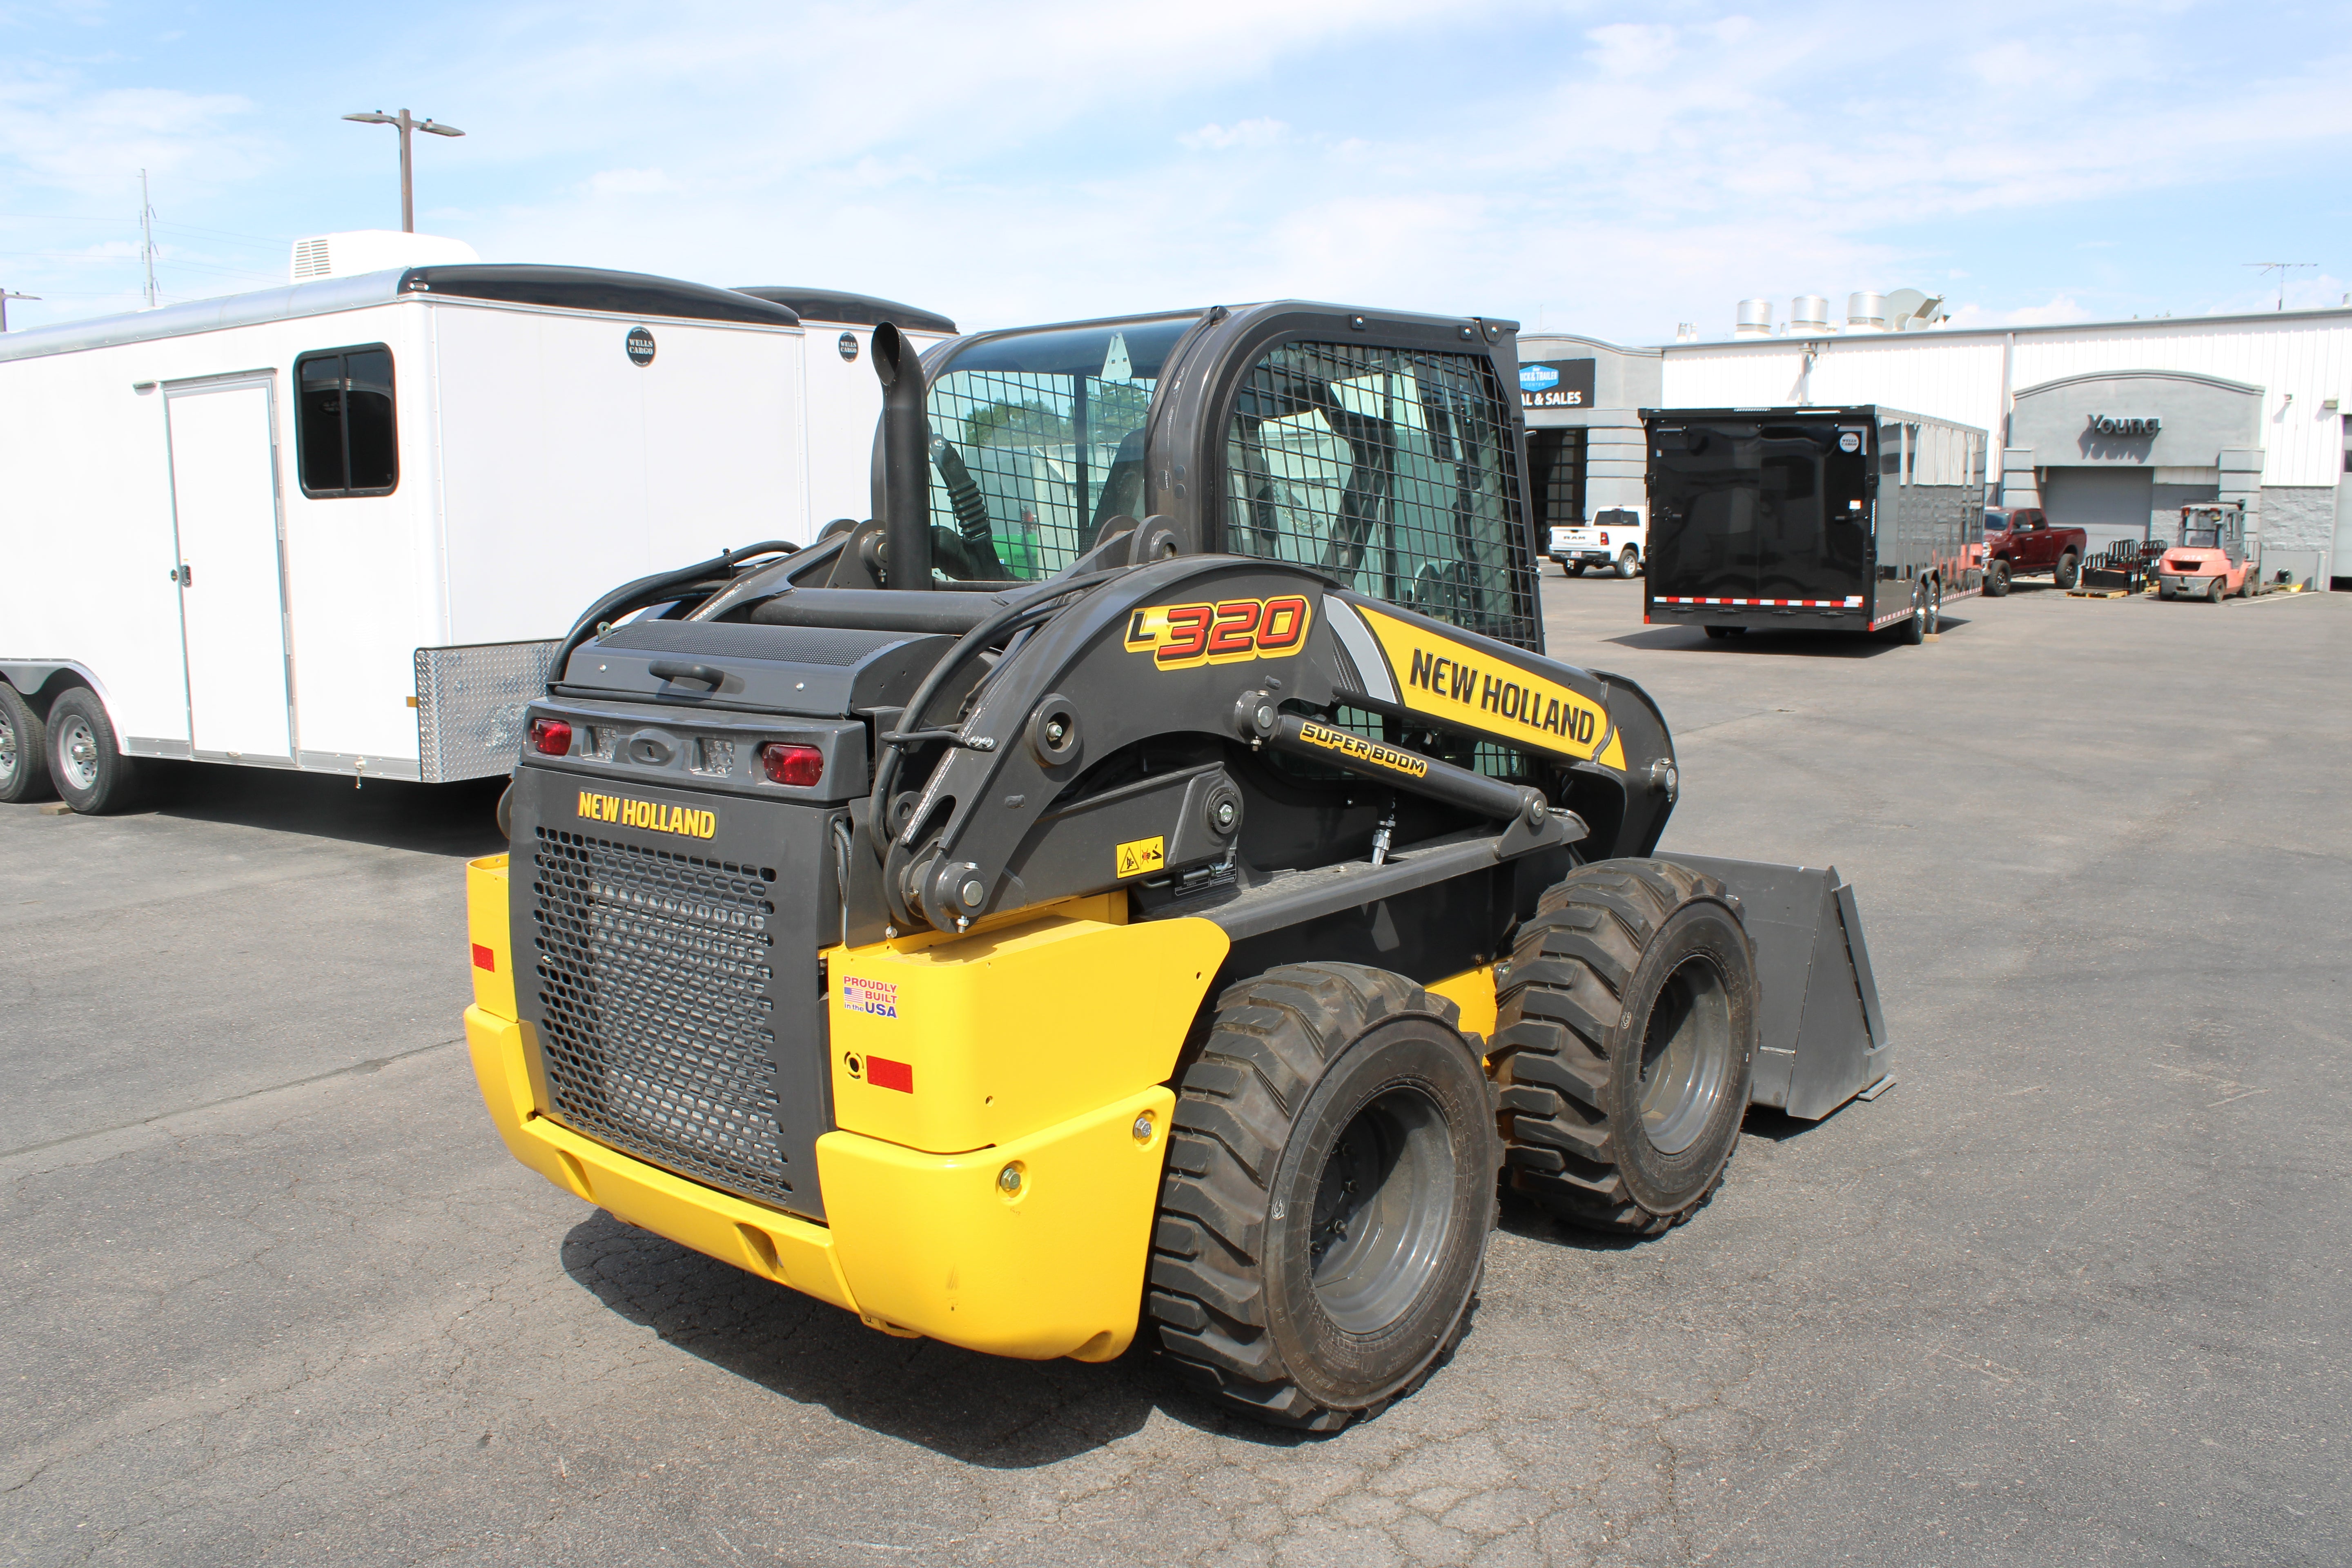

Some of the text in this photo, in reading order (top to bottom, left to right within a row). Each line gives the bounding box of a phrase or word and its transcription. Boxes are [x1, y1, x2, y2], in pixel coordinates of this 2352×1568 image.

[629, 339, 653, 347] WELLS
[629, 347, 653, 355] CARGO
[1536, 372, 1557, 381] TRAILER
[1534, 392, 1544, 406] &
[1545, 391, 1581, 405] SALES
[2087, 414, 2159, 438] Young
[1126, 596, 1308, 666] L320
[1409, 647, 1595, 744] NEW HOLLAND
[1301, 723, 1426, 775] SUPER BOOM
[578, 791, 715, 839] NEW HOLLAND
[844, 976, 897, 993] PROUDLY
[865, 990, 897, 1004] BUILT
[865, 1001, 897, 1018] USA
